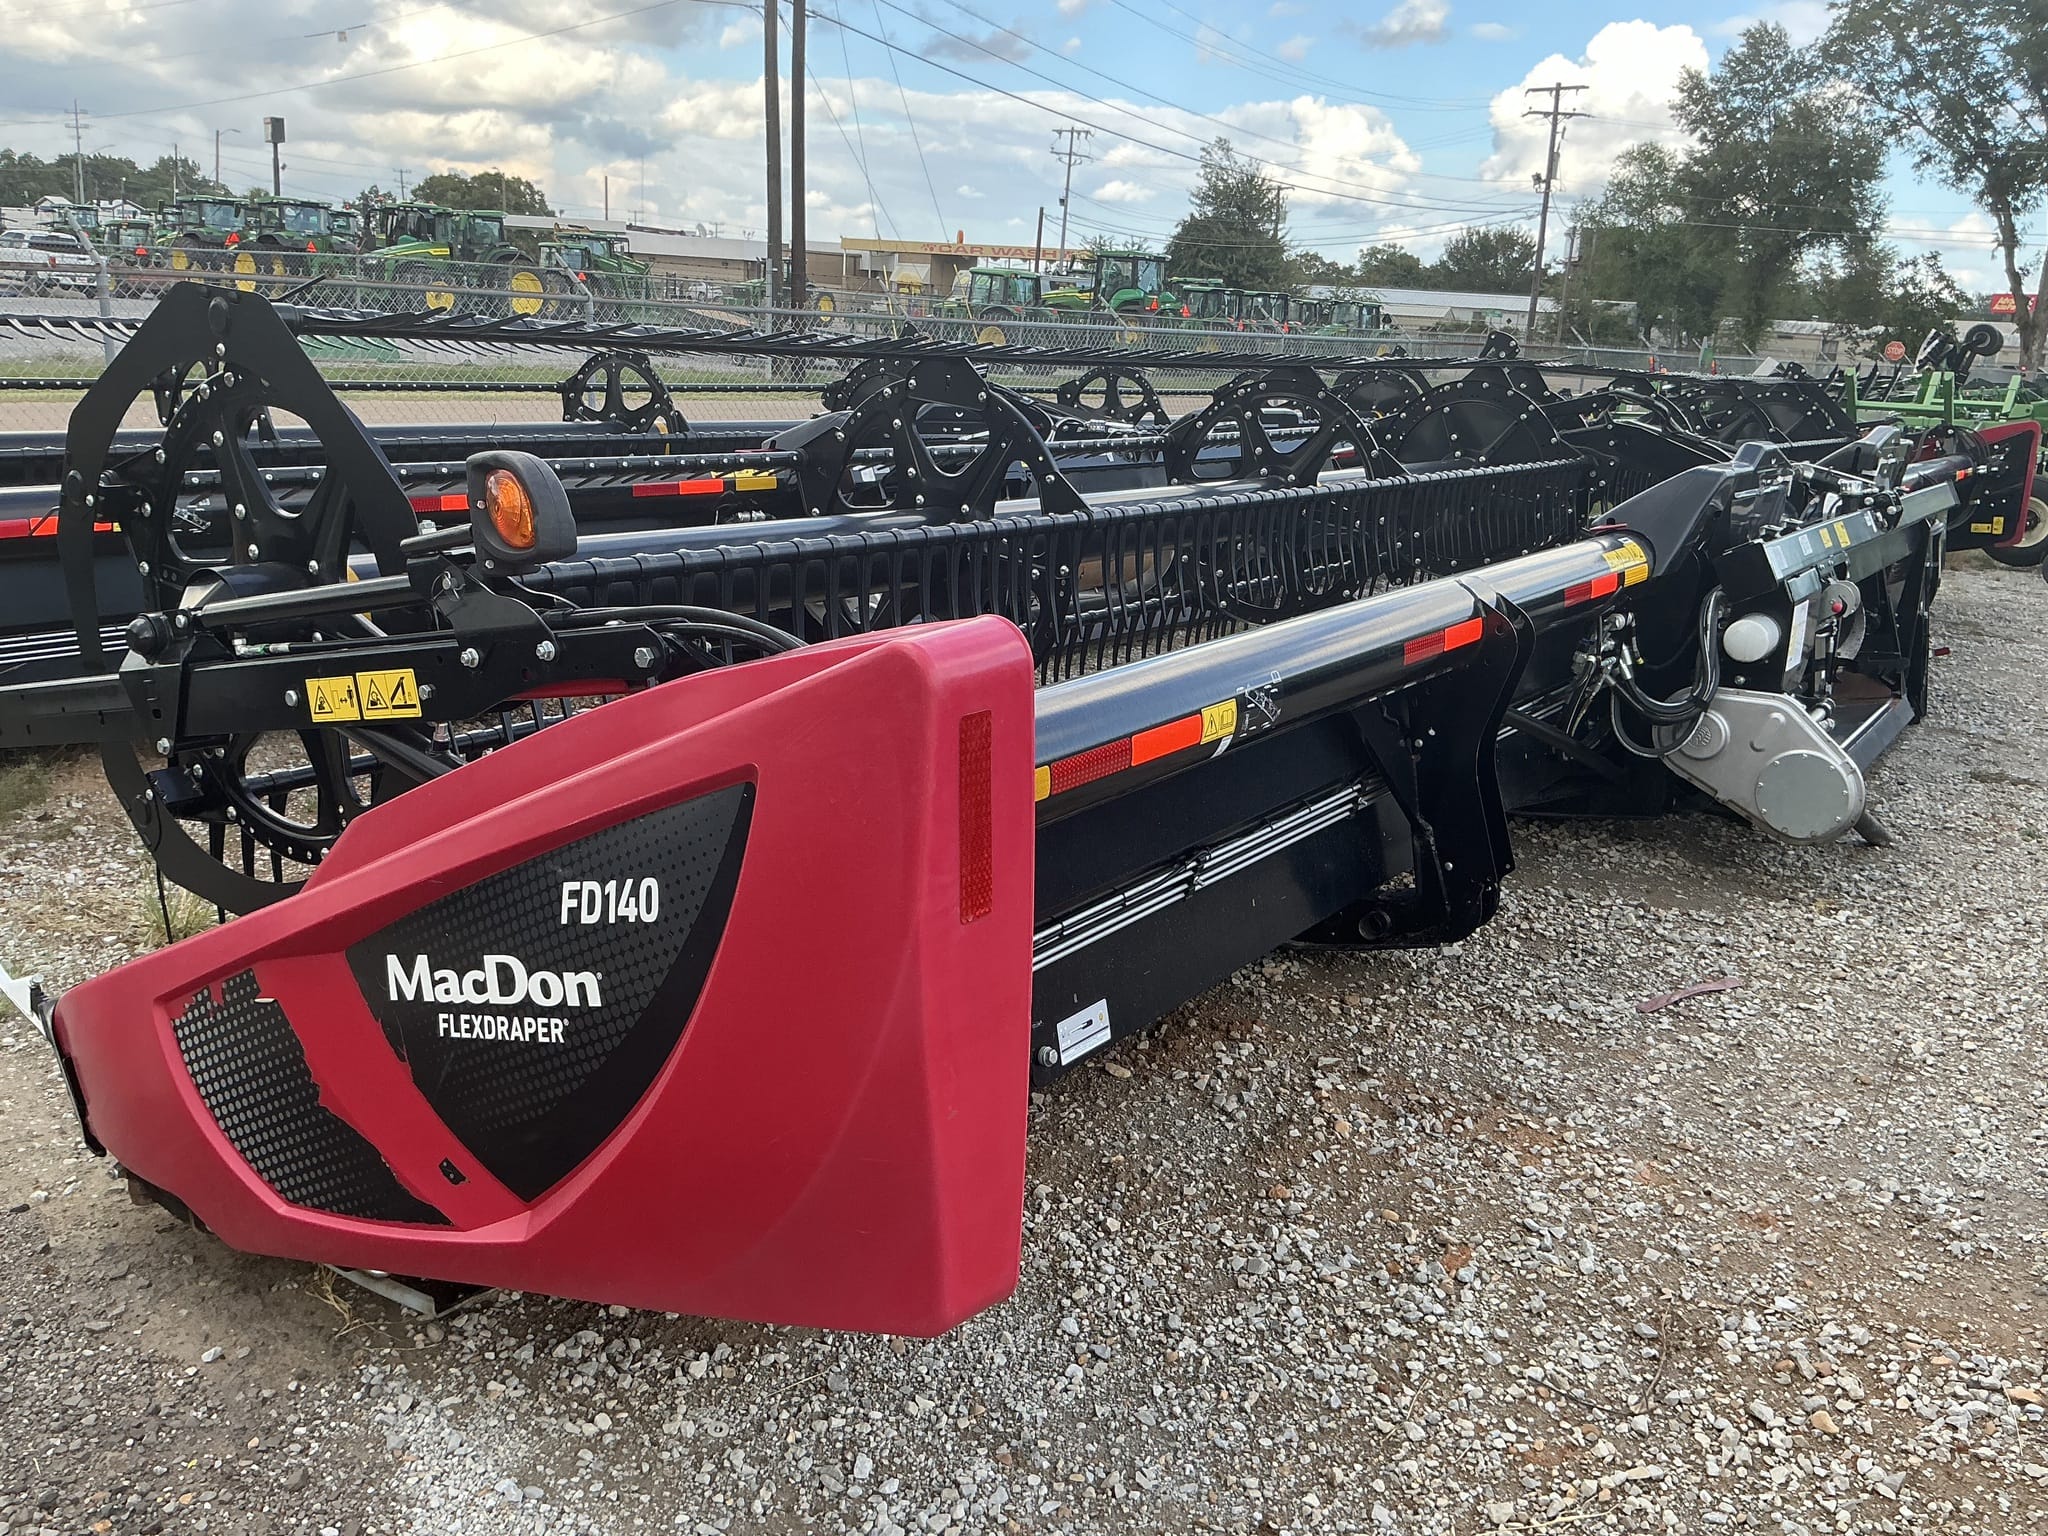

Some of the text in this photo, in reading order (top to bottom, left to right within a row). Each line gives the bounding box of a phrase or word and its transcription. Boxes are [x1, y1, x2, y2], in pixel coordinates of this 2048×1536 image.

[938, 244, 1057, 259] CAR WASH
[560, 876, 660, 925] FD140
